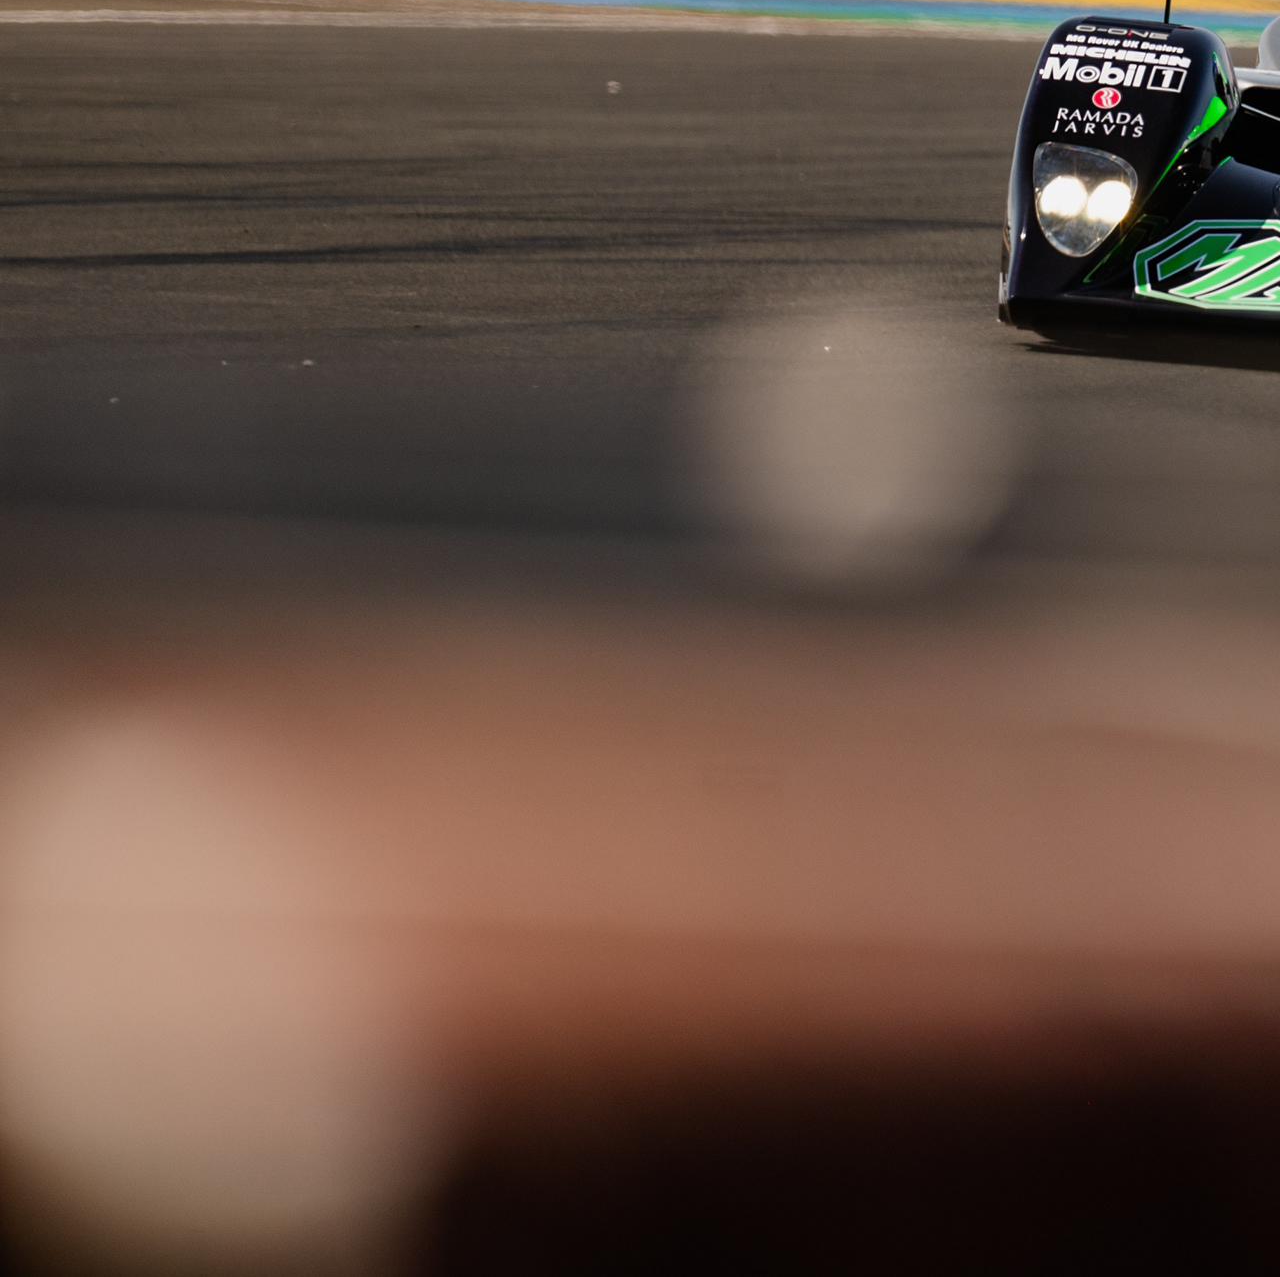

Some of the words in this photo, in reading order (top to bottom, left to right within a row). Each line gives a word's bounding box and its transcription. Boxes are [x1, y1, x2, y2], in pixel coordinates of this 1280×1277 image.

[1066, 34, 1086, 43] MG
[1088, 36, 1120, 47] Rover
[1122, 40, 1140, 49] UK
[1141, 42, 1184, 54] Dealers
[1050, 44, 1191, 68] MICHELIN
[1042, 57, 1147, 87] Mobil
[1057, 107, 1145, 125] RAMADA
[1052, 121, 1143, 138] JARVIS
